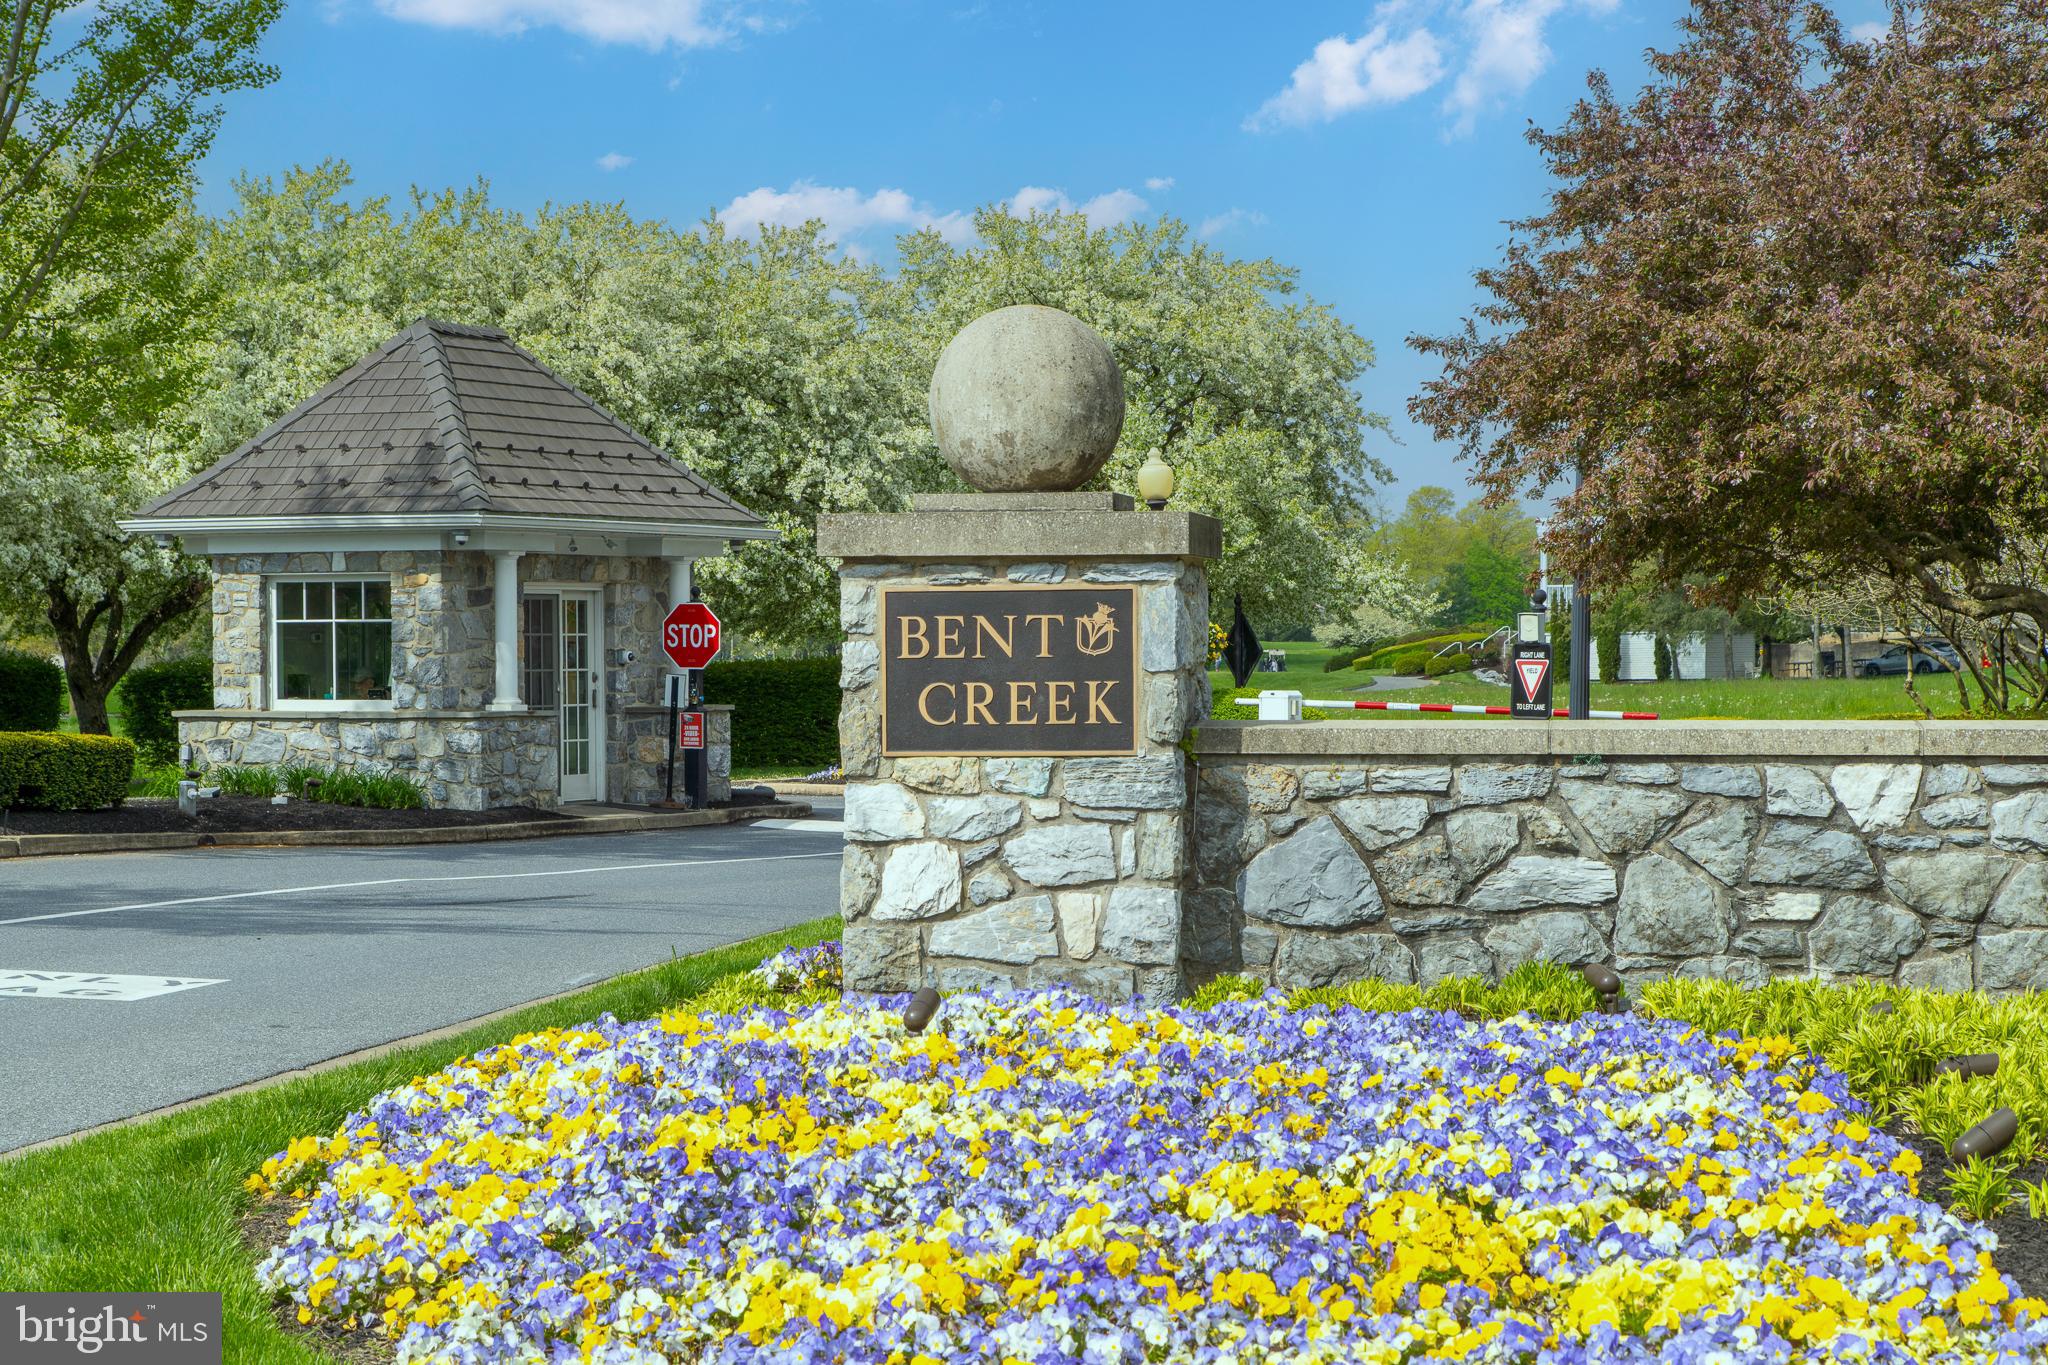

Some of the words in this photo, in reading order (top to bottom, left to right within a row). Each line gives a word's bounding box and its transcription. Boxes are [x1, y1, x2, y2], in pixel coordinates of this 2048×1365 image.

[667, 623, 716, 648] STOP
[896, 614, 1064, 659] BENT
[1533, 651, 1545, 659] LANE
[918, 680, 1123, 726] CREEK
[1533, 703, 1546, 711] LANE
